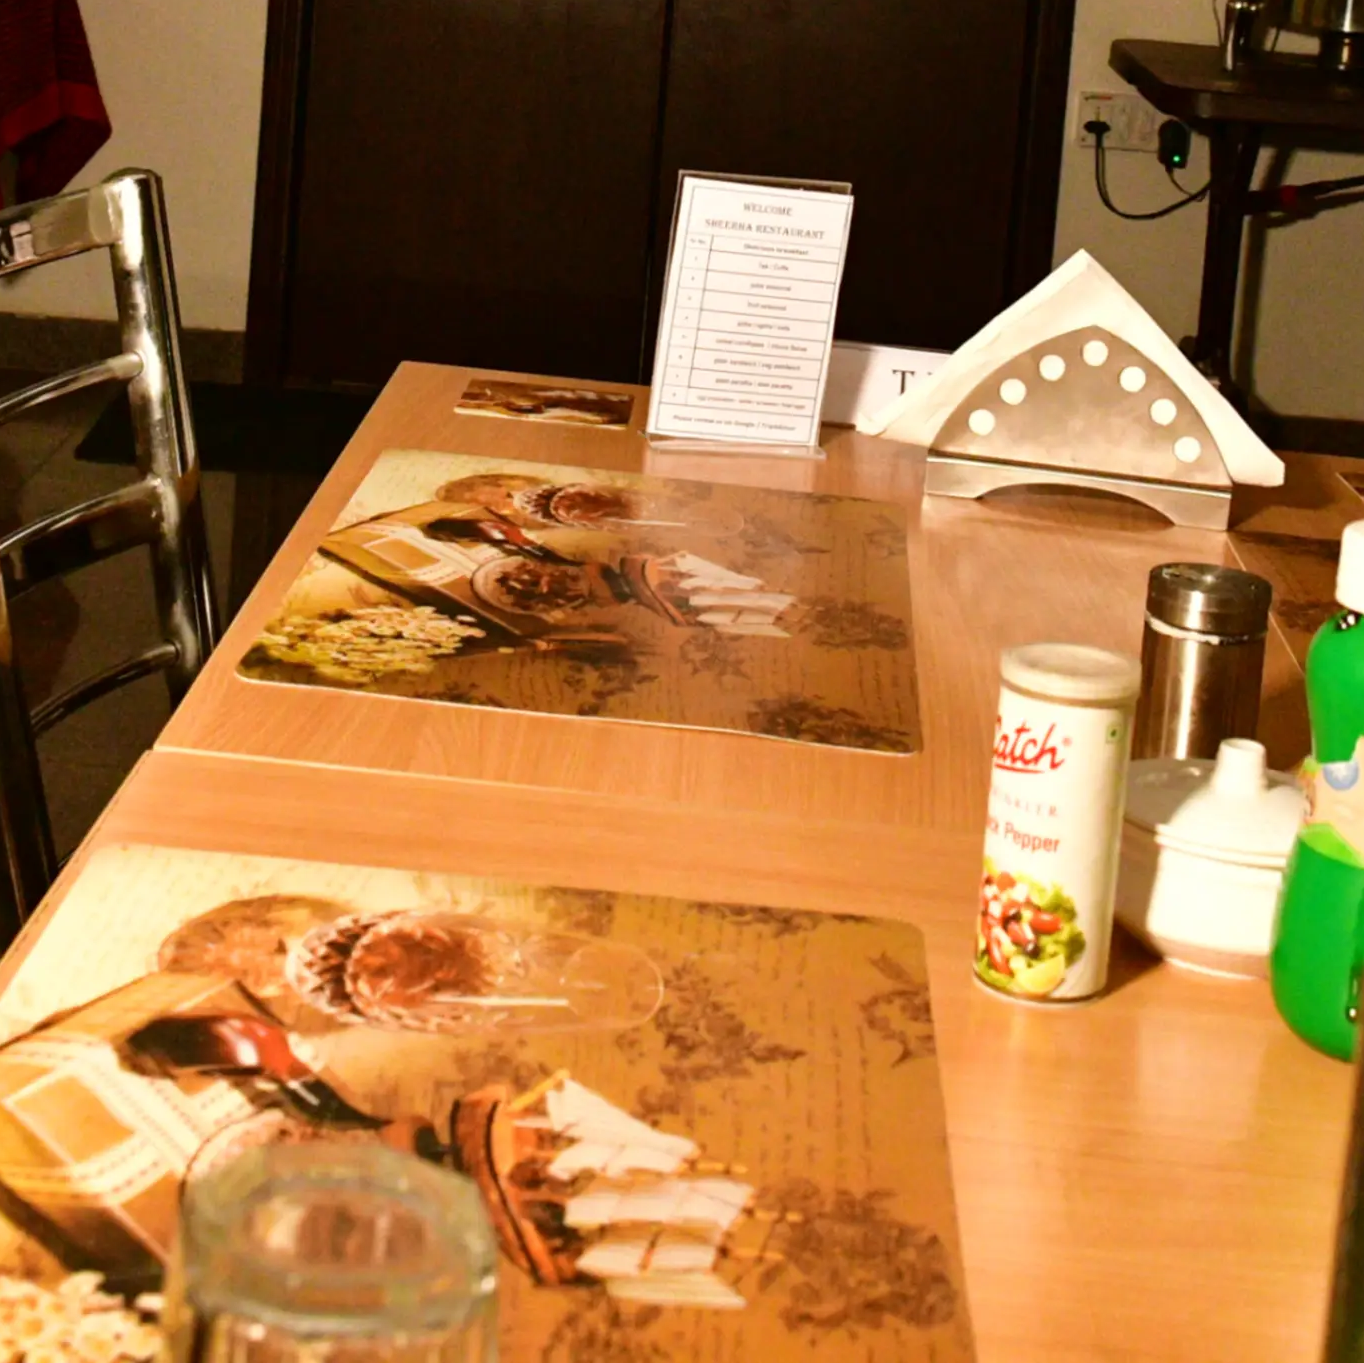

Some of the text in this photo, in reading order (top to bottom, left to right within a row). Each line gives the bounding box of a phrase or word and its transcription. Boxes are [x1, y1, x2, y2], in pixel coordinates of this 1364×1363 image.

[743, 202, 792, 216] WELCOME
[755, 224, 825, 240] RESTAURANT
[991, 715, 1065, 770] atch
[1004, 821, 1060, 853] Pepper
